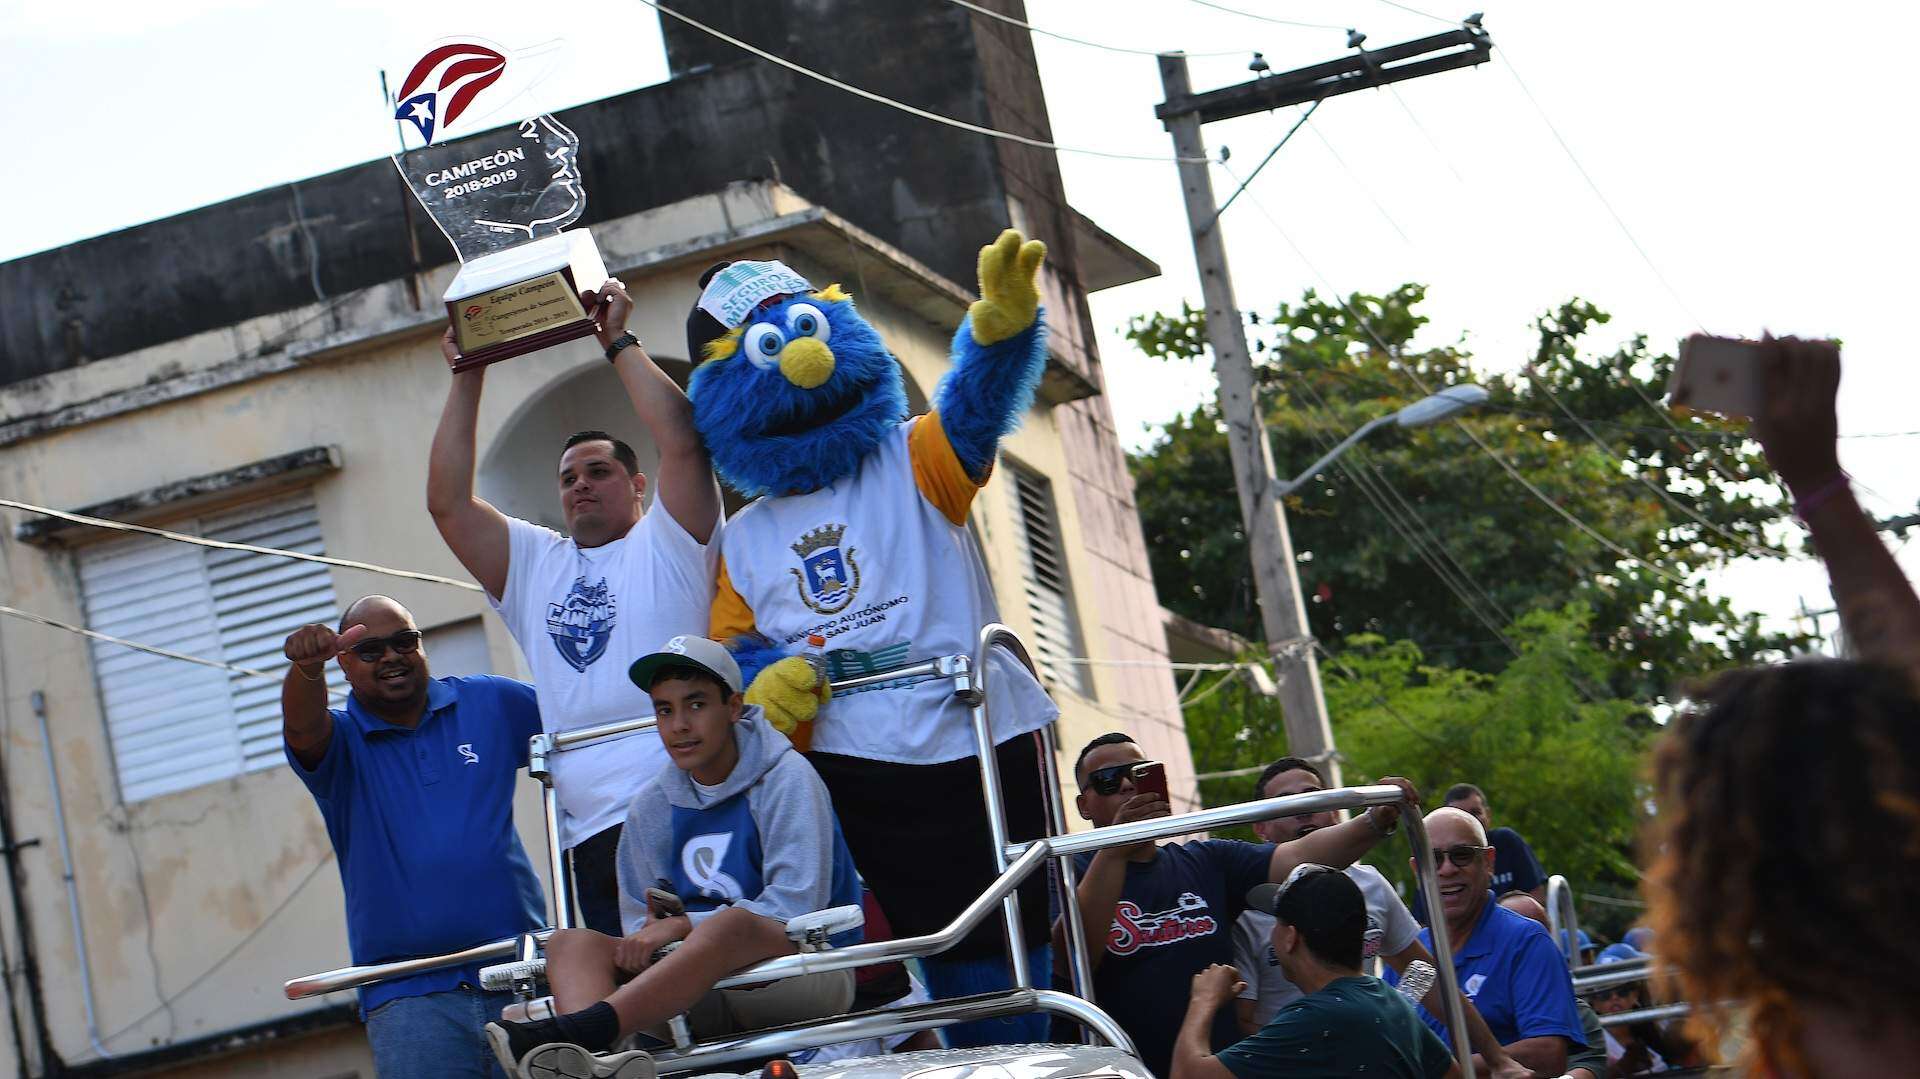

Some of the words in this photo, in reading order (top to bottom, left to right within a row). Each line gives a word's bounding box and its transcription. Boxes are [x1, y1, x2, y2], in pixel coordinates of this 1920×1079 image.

[425, 147, 525, 187] CAMPEÓN
[443, 169, 518, 199] 2018-2019
[489, 291, 518, 305] Equipo
[721, 272, 791, 313] SEGUROS
[840, 596, 909, 625] AUTÓNOMO
[826, 625, 851, 639] SAN
[853, 613, 887, 630] JUAN
